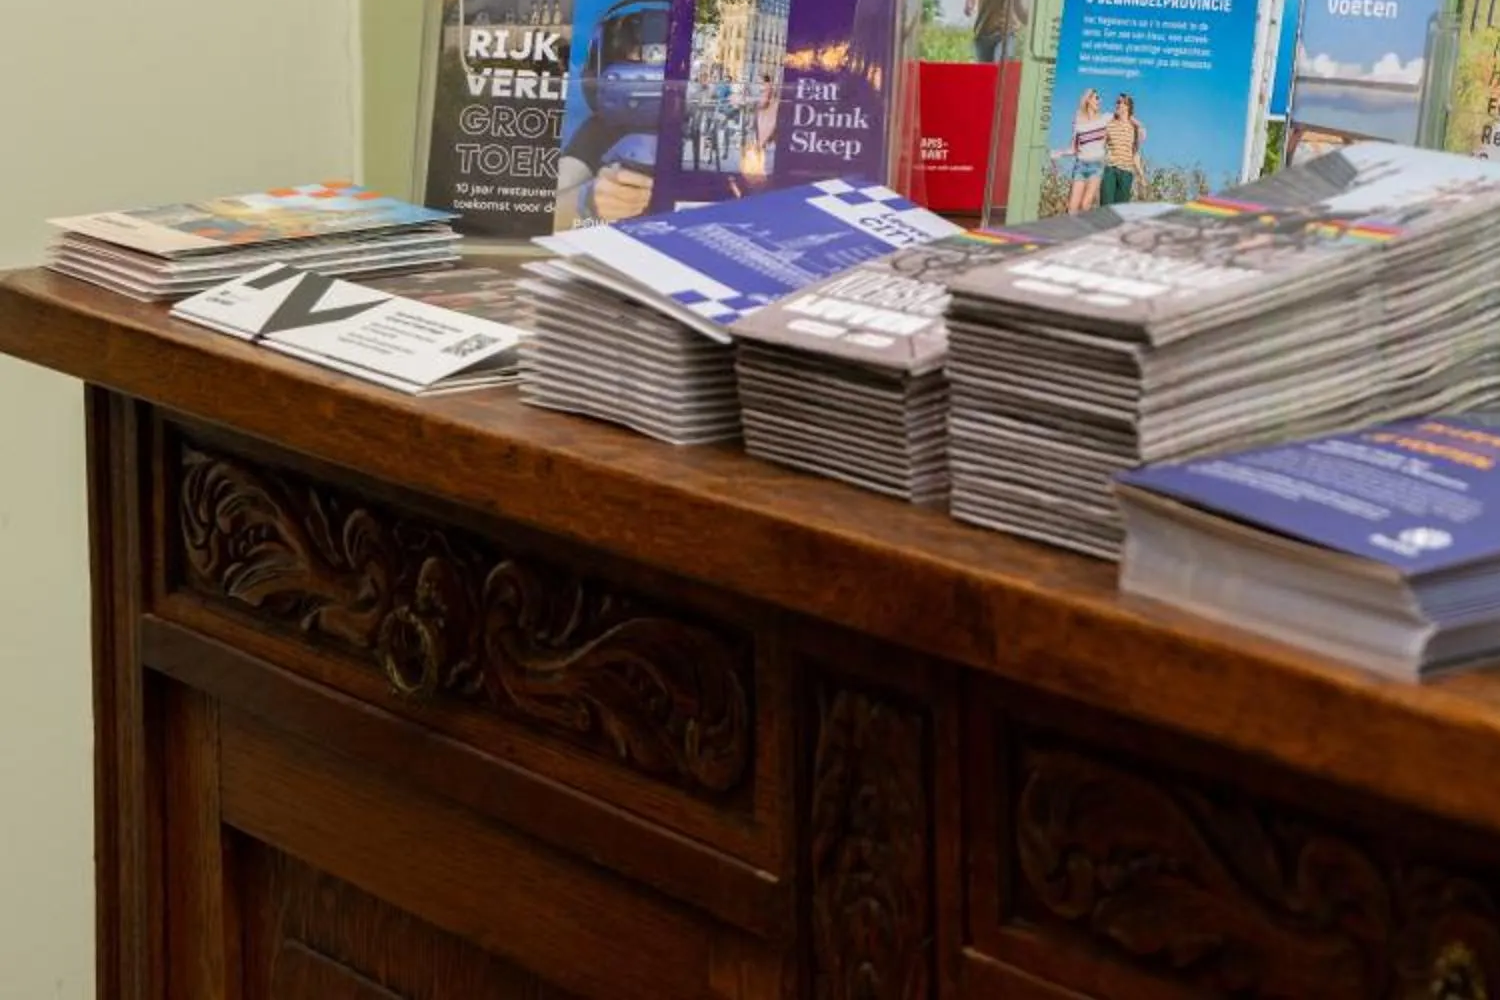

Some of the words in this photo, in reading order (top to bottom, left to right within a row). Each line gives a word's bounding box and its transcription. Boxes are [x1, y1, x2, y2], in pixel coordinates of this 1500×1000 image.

[468, 28, 561, 62] RIJK
[793, 105, 870, 131] Drink
[789, 131, 862, 161] Sleep
[456, 143, 560, 178] TOEK
[470, 183, 495, 199] jaar
[453, 198, 510, 212] toekomst
[513, 202, 541, 214] voor
